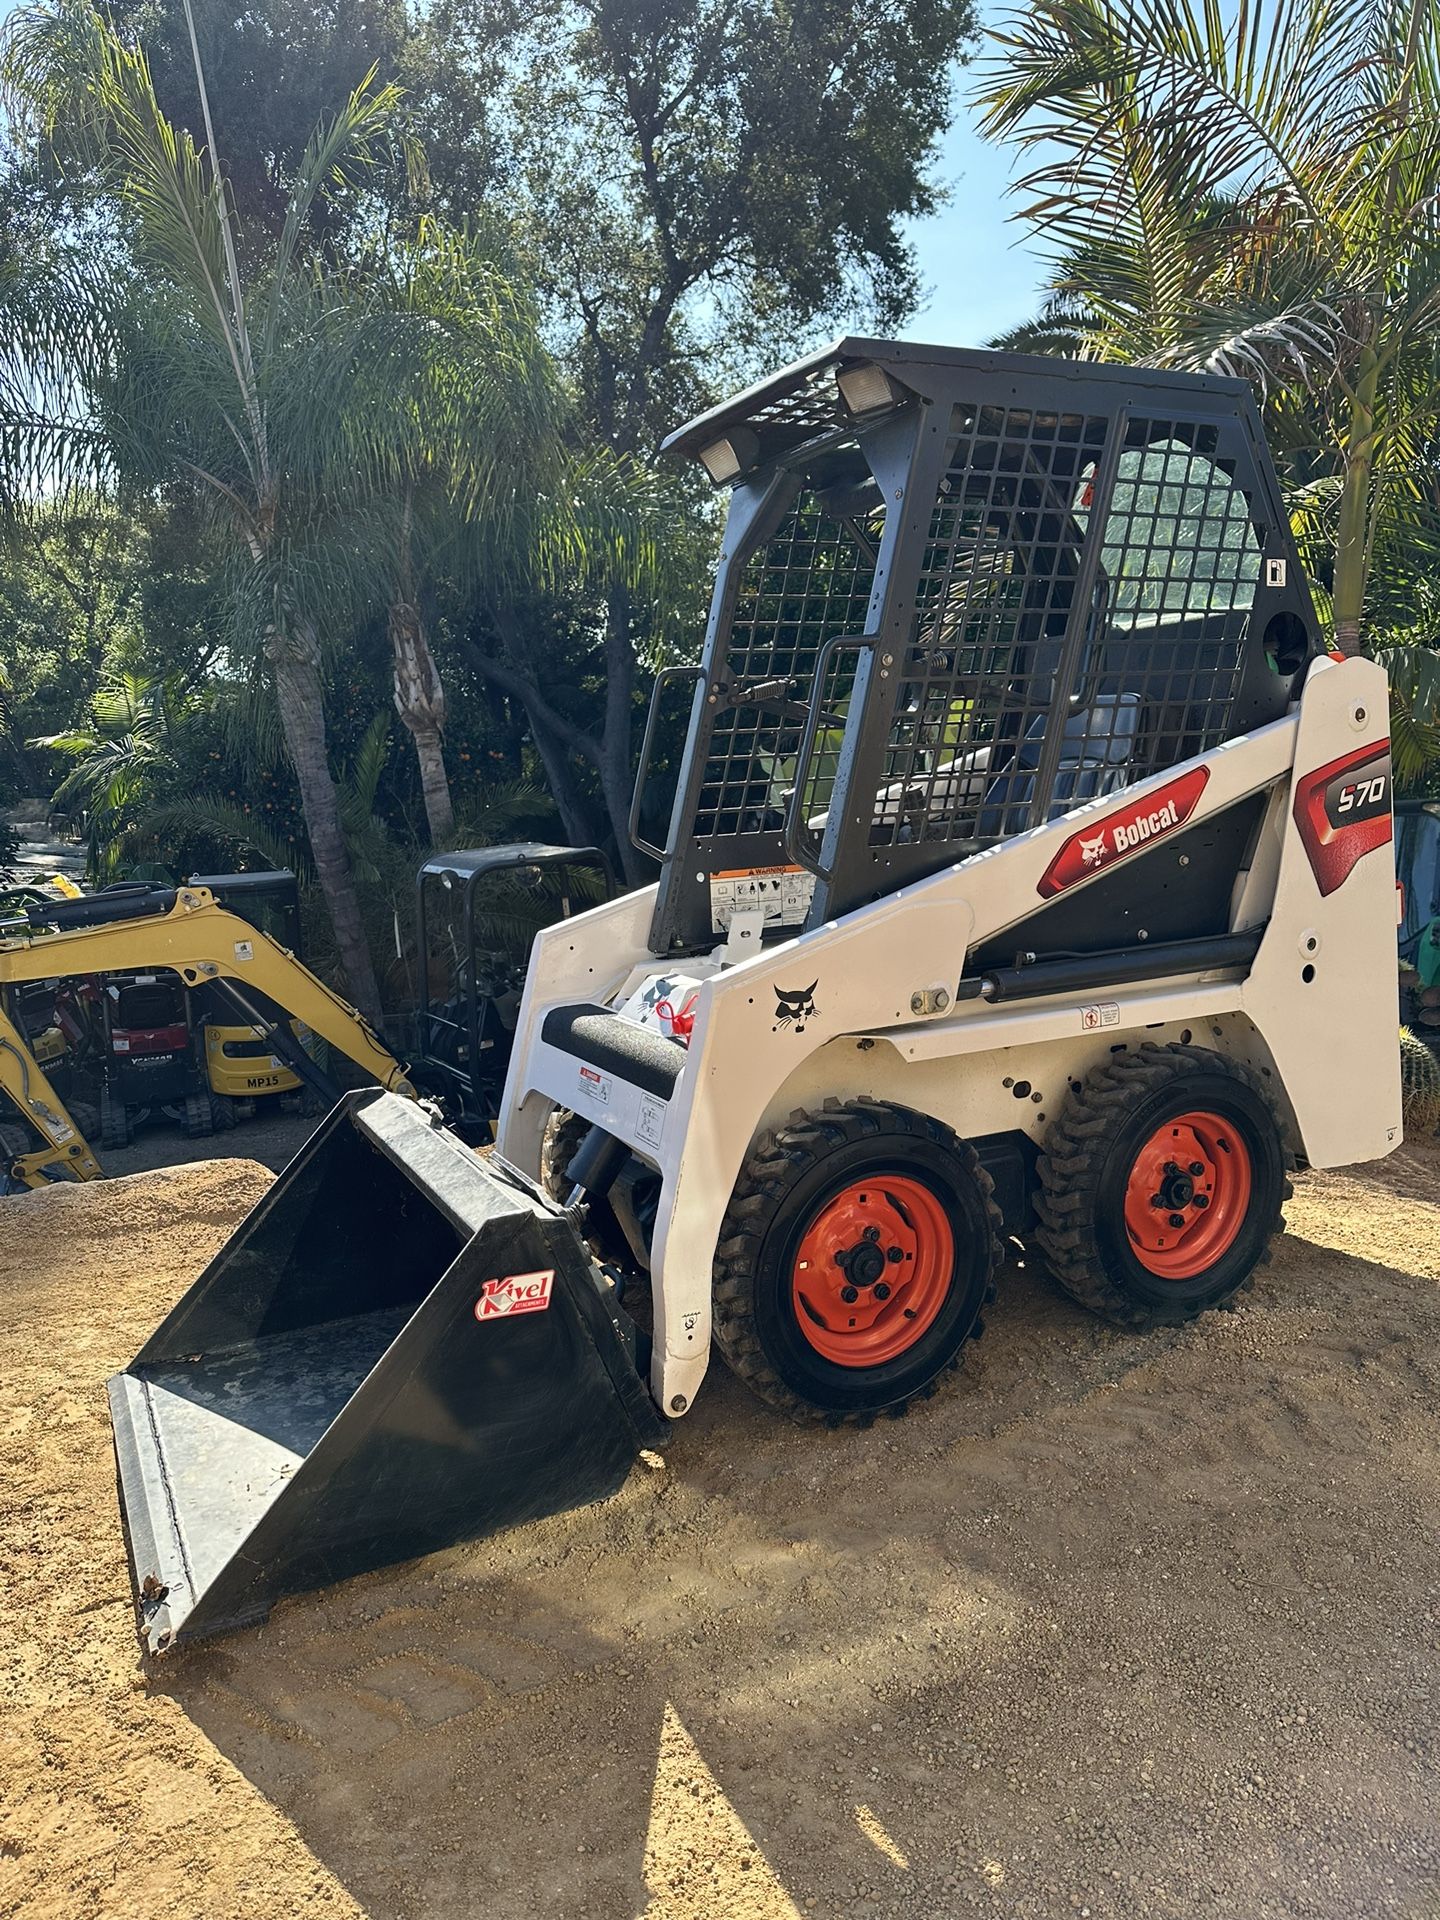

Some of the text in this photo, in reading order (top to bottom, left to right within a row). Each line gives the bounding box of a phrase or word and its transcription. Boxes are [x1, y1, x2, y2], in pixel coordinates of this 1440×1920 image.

[1338, 775, 1386, 813] S70
[1112, 799, 1179, 853] Bobcat
[755, 865, 787, 875] WARNING
[247, 1075, 279, 1088] MP15
[483, 1277, 549, 1315] Kivel
